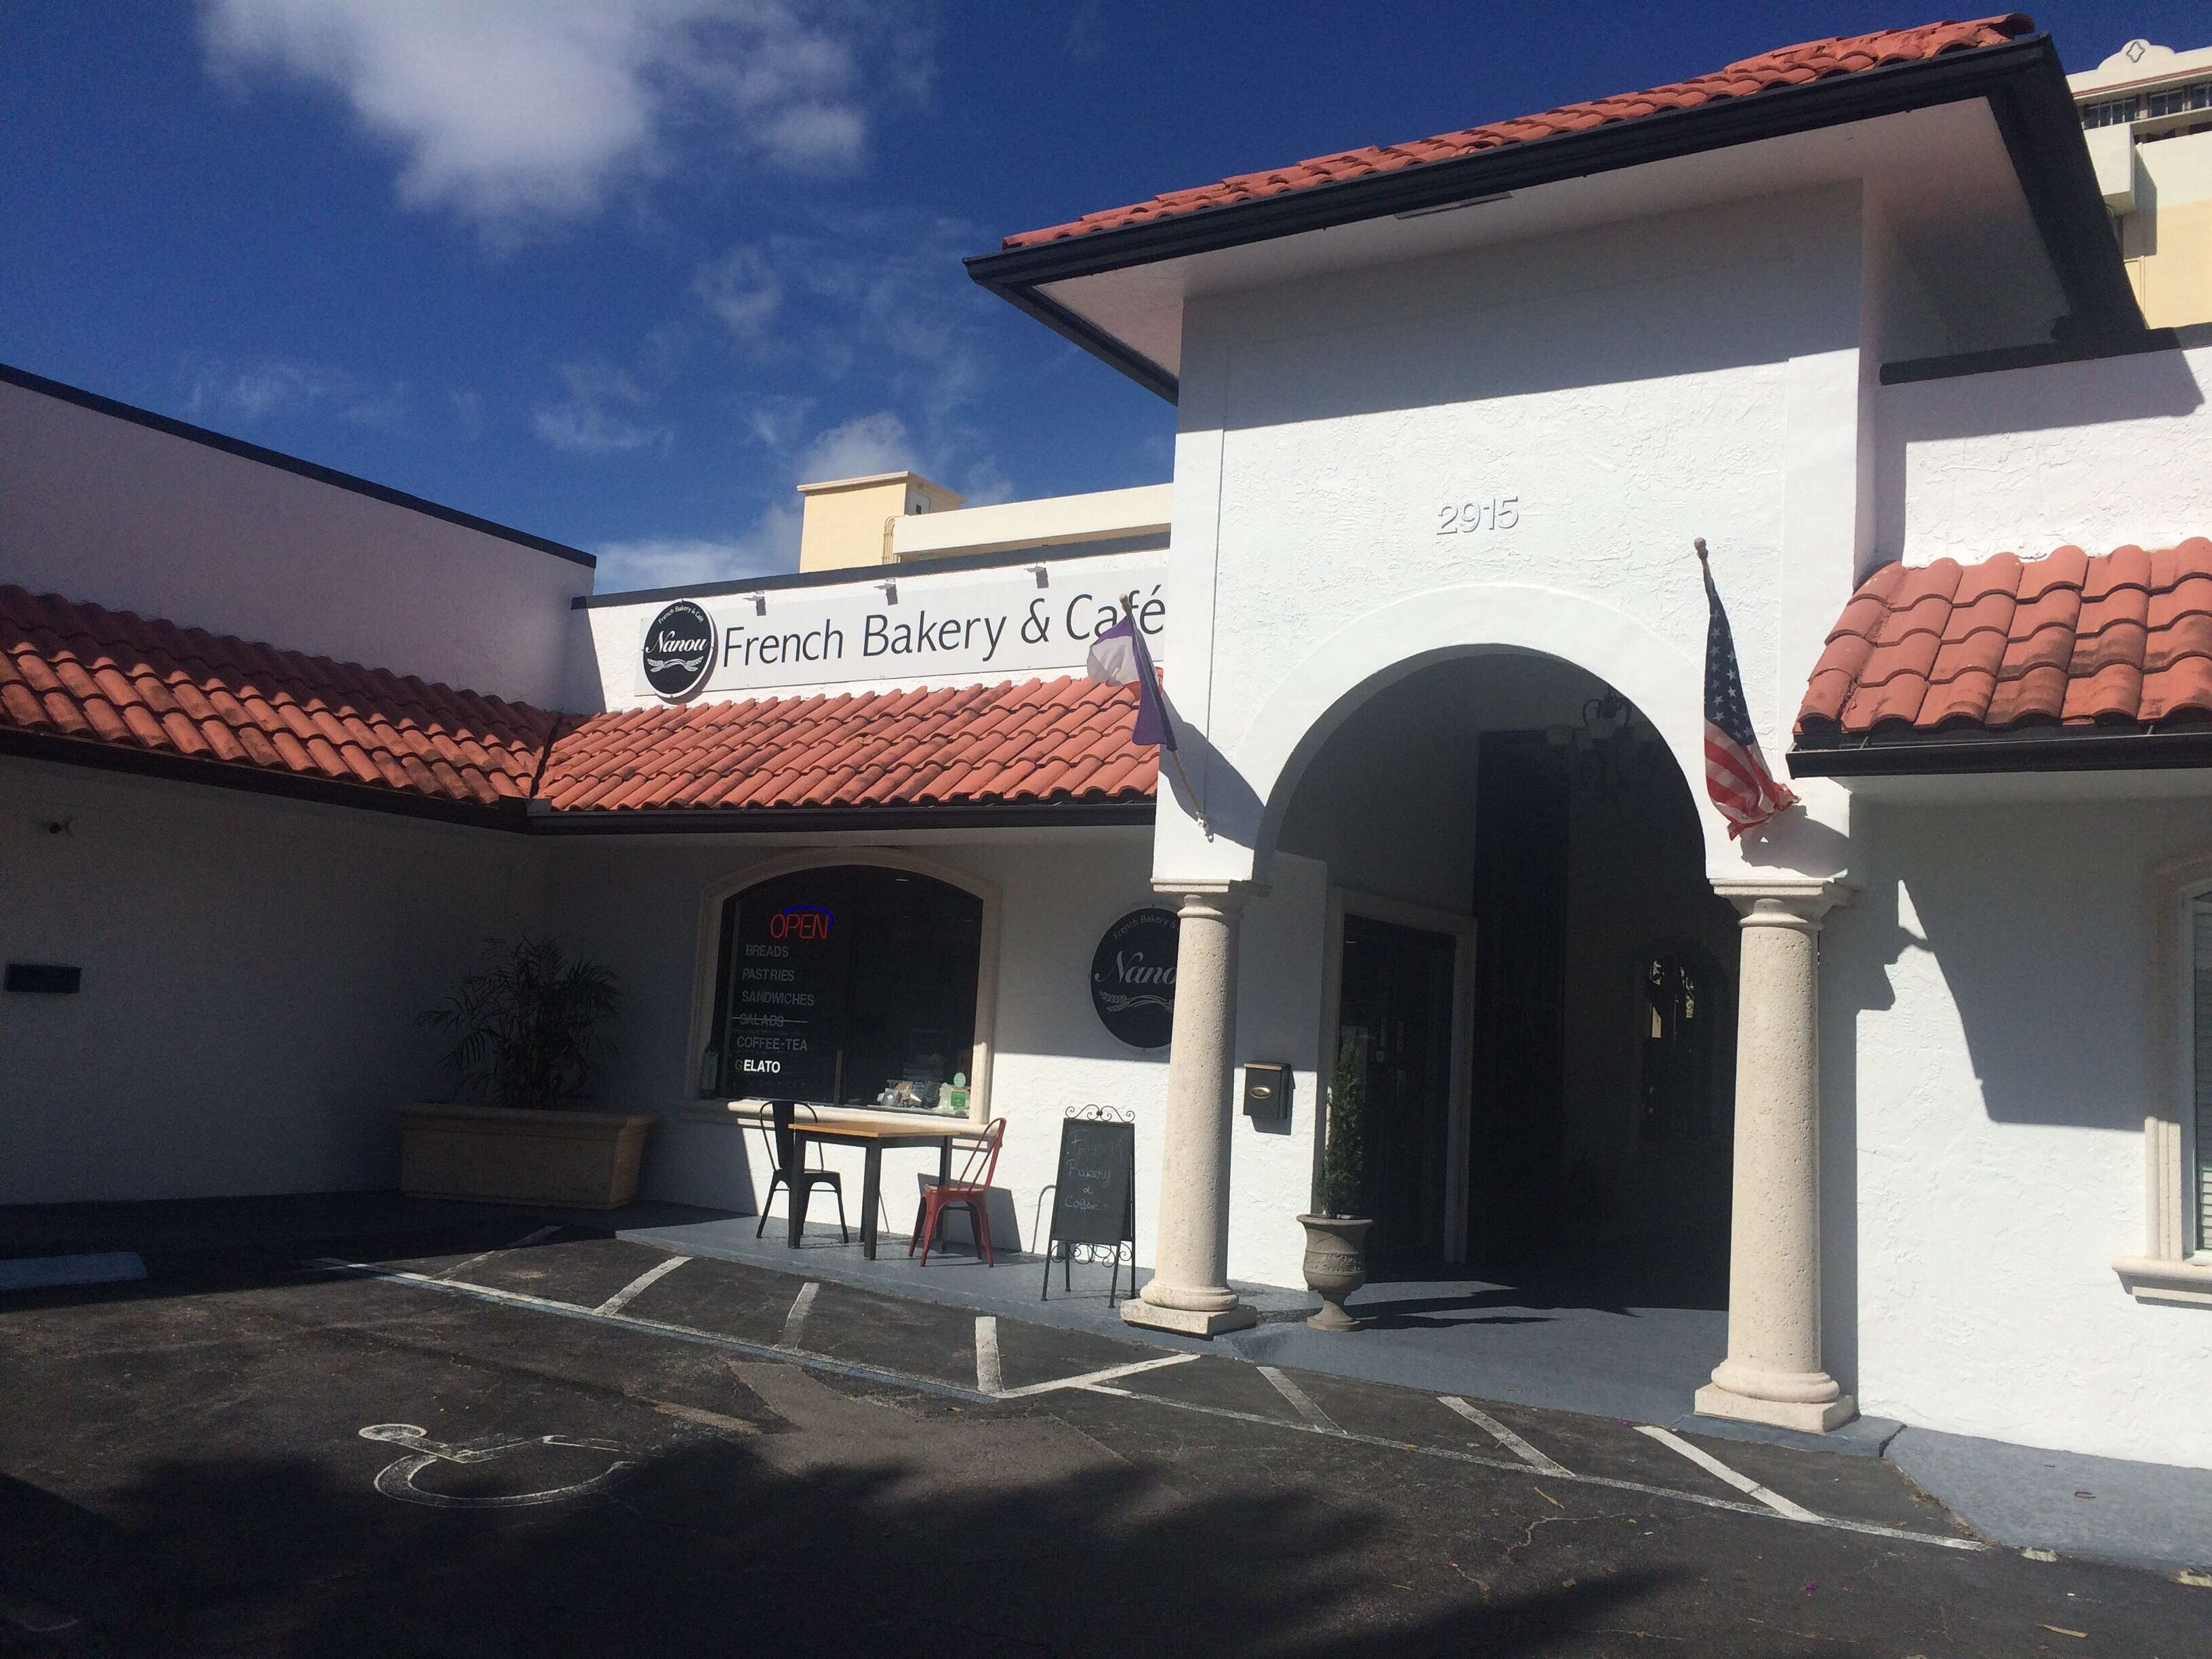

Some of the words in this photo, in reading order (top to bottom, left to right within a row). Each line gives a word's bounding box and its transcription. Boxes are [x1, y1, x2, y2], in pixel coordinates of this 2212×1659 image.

[1436, 495, 1519, 535] 2915
[658, 609, 674, 624] French
[675, 605, 692, 613] Bakery
[645, 630, 709, 653] Nanou
[723, 618, 844, 668] French
[863, 596, 1007, 662] Bakery
[1021, 598, 1050, 644] &
[770, 913, 829, 939] OPEN
[1112, 918, 1139, 939] French
[1140, 914, 1167, 927] Bakery
[745, 944, 789, 958] BREADS
[742, 968, 795, 982] PASTRIES
[1094, 950, 1177, 985] Nano
[742, 990, 815, 1006] SANDWICHES
[739, 1013, 784, 1027] SALADS
[737, 1036, 808, 1051] COFFEE-TEA
[735, 1059, 781, 1073] GELATO
